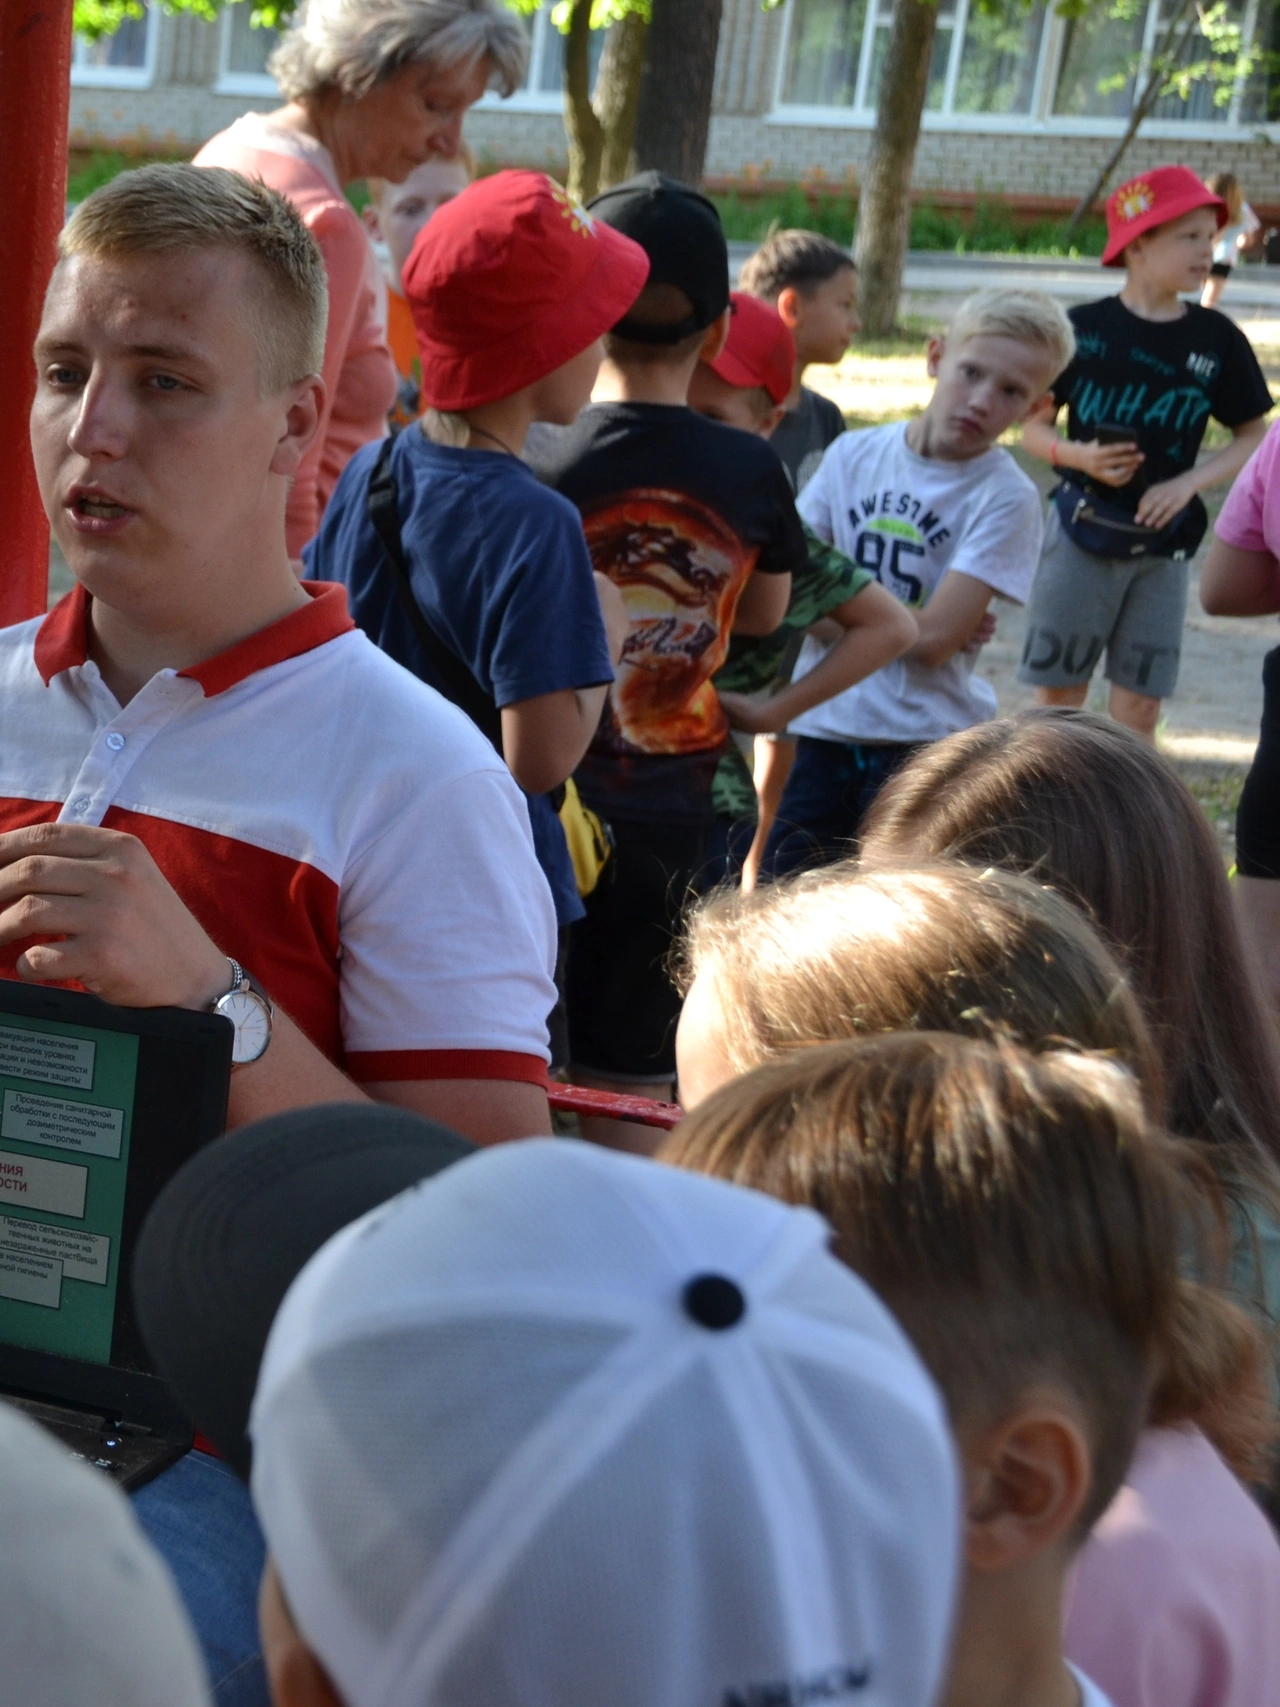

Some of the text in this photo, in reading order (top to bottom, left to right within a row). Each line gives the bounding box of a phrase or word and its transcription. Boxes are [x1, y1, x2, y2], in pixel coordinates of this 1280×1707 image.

[10, 1044, 42, 1056] высоких
[44, 1049, 76, 1062] уровнях
[36, 1038, 79, 1051] населения
[27, 1057, 88, 1075] невозможности
[23, 1067, 49, 1080] режим
[50, 1072, 81, 1084] защиты
[16, 1093, 111, 1119] Проведение санитарной
[10, 1104, 51, 1120] обработки
[59, 1113, 116, 1131] последующим
[26, 1119, 96, 1138] дозиметрическим
[39, 1131, 81, 1146] контролем
[3, 1217, 37, 1231] Перевод
[8, 1230, 40, 1243] твенных
[41, 1236, 80, 1251] животных
[5, 1254, 54, 1270] населением
[17, 1267, 48, 1280] гигиены
